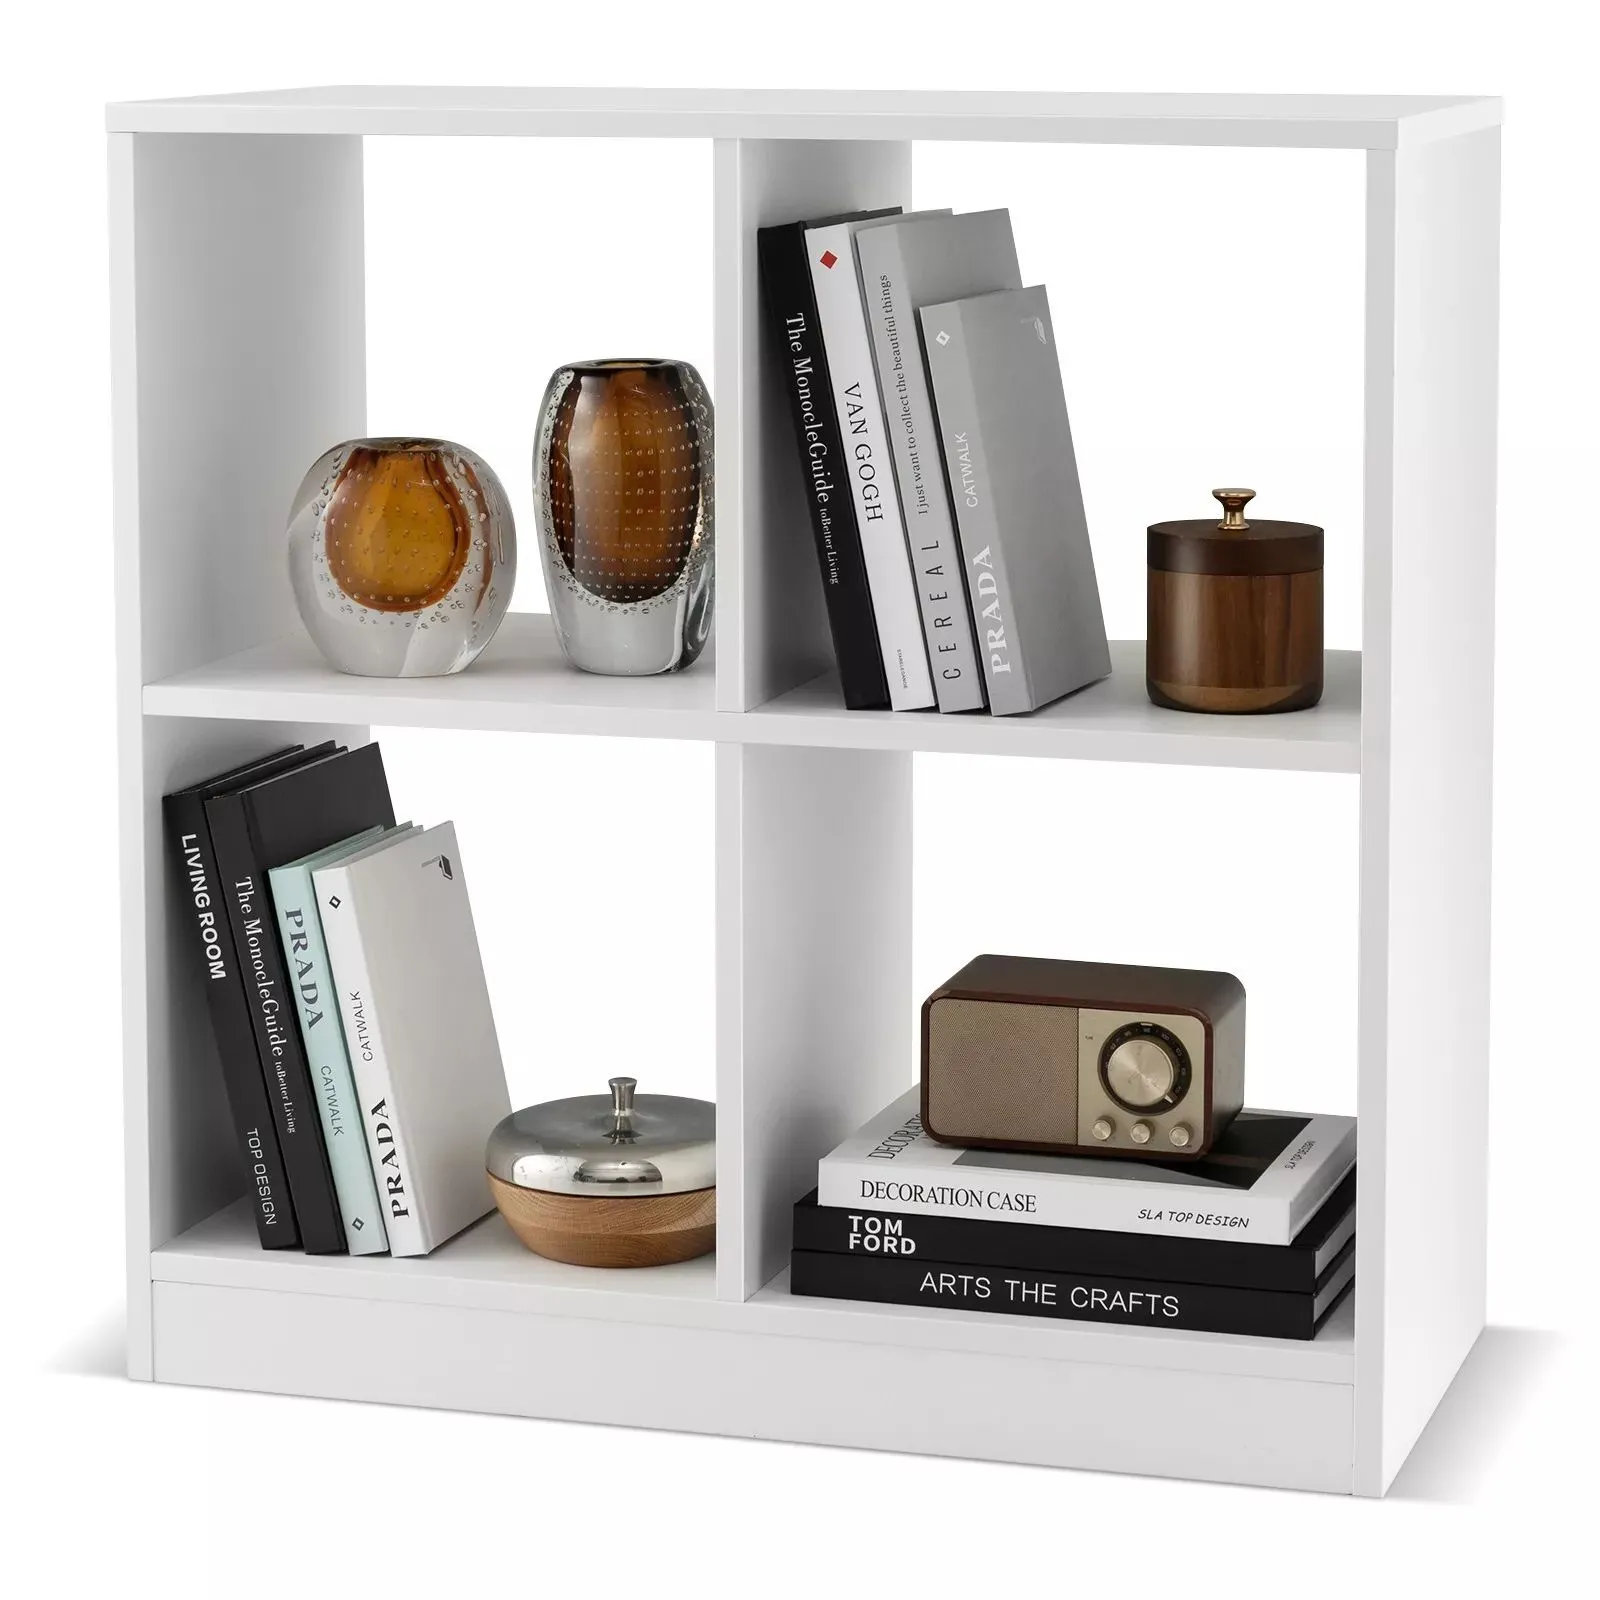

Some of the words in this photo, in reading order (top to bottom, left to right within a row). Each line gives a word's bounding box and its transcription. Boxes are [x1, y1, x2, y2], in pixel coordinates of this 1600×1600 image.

[880, 274, 893, 314] things
[885, 315, 903, 371] beautiful
[844, 382, 868, 435] VAN
[895, 373, 907, 394] the
[899, 394, 914, 434] collect
[786, 312, 806, 352] The
[828, 550, 839, 584] Living
[908, 436, 916, 449] to
[909, 451, 922, 482] want
[954, 431, 979, 508] CATWALK
[855, 443, 884, 522] GOGH
[915, 483, 929, 508] just
[921, 540, 961, 680] CEREAL
[972, 545, 1011, 676] PRADA
[182, 833, 211, 909] LIVING
[198, 912, 226, 980] ROOM
[285, 908, 324, 1030] PRADA
[235, 876, 255, 914] The
[284, 1102, 295, 1134] Living
[350, 990, 373, 1061] CATWALK
[320, 1065, 344, 1136] CATWALK
[247, 1128, 263, 1160] TOP
[371, 1098, 410, 1219] PRADA
[254, 1163, 277, 1225] DESIGN
[860, 1180, 984, 1209] DECORATION
[987, 1191, 1038, 1213] CASE
[1138, 1209, 1163, 1221] SLA
[1168, 1211, 1194, 1223] TOP
[1195, 1214, 1250, 1228] DESIGN
[848, 1215, 903, 1236] TOM
[849, 1233, 916, 1255] FORD
[920, 1272, 991, 1298] ARTS
[1004, 1279, 1057, 1305] THE
[1071, 1286, 1180, 1318] CRAFTS
